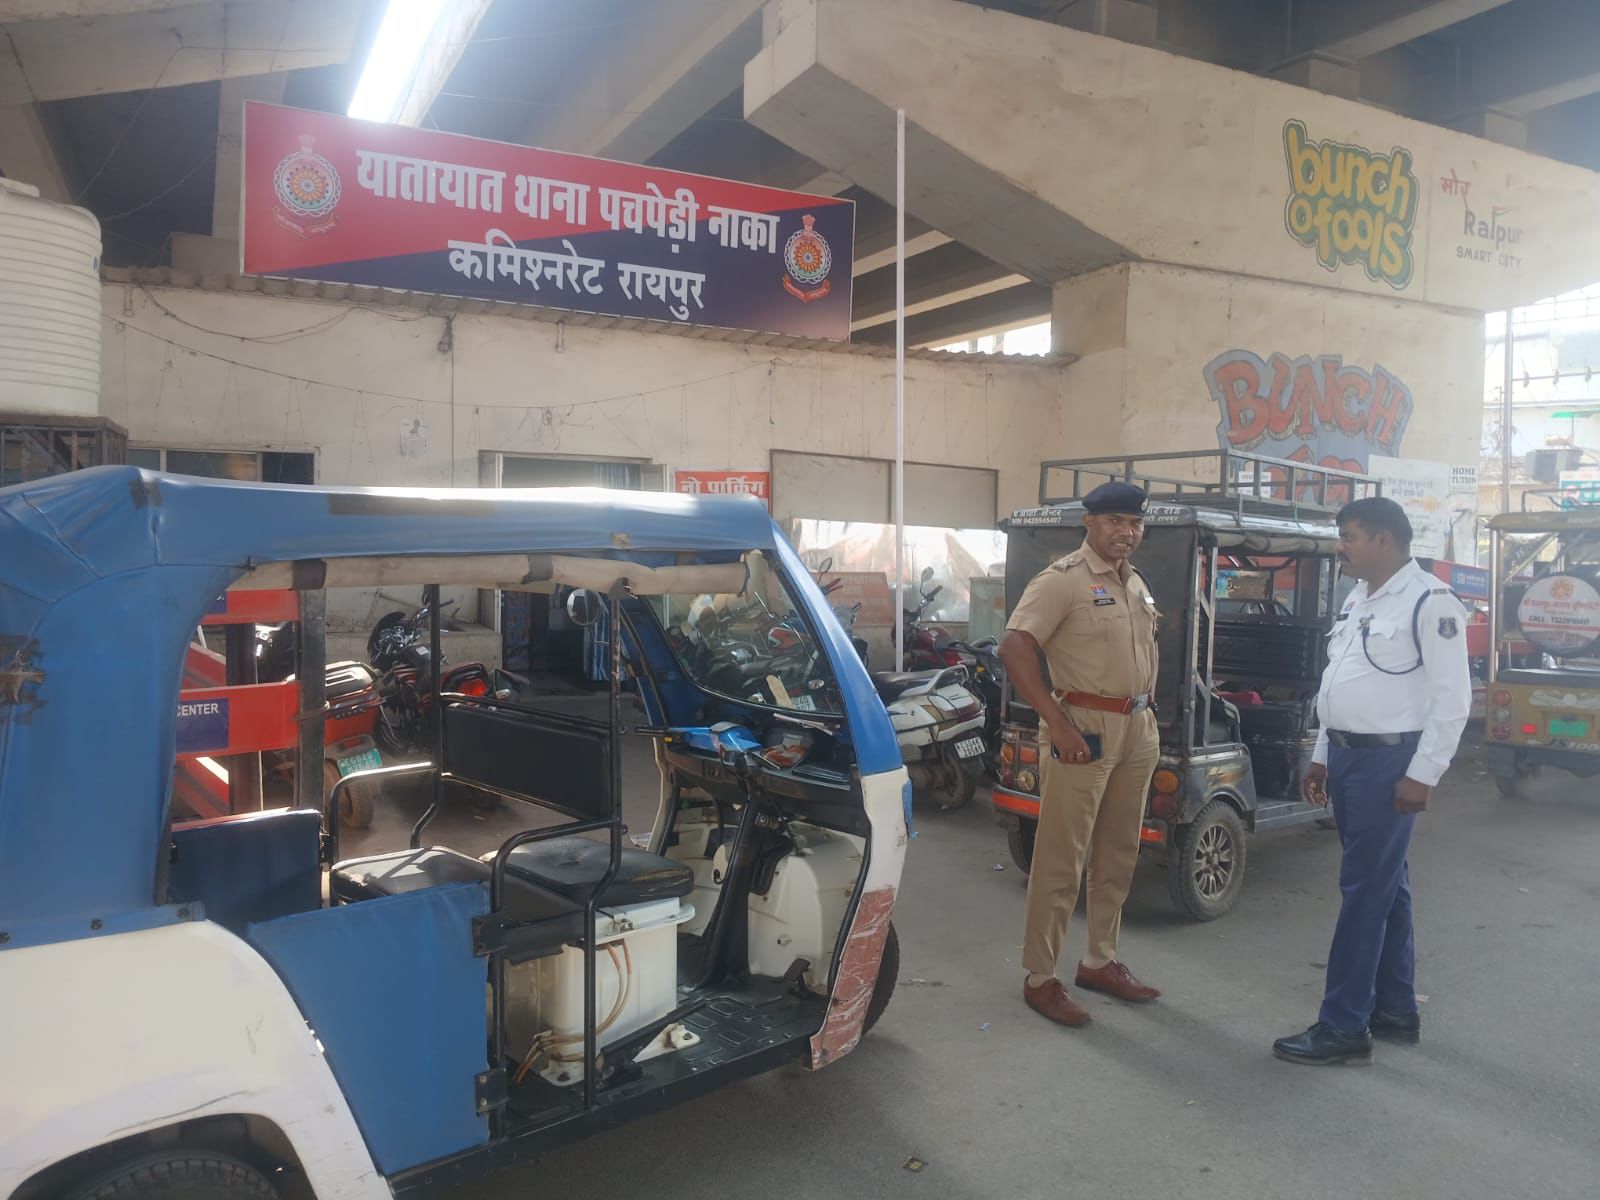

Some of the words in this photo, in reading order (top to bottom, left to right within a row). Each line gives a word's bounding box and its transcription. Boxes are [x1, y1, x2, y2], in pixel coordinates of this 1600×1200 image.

[1288, 127, 1409, 222] bunch
[1440, 168, 1471, 209] मोर
[356, 149, 506, 214] यातायात
[515, 174, 590, 226] थाना
[598, 182, 700, 254] पचपेड़ी
[707, 205, 780, 254] नाका
[447, 228, 605, 295] कमिश्नरेट
[617, 262, 706, 321] रायपुर
[1456, 246, 1491, 263] SMART
[1498, 254, 1521, 271] CITY
[1213, 359, 1405, 446] BUNCH
[680, 476, 702, 495] नो
[1452, 467, 1476, 475] HOME
[1452, 476, 1477, 485] TUTION
[1528, 615, 1545, 623] CALL
